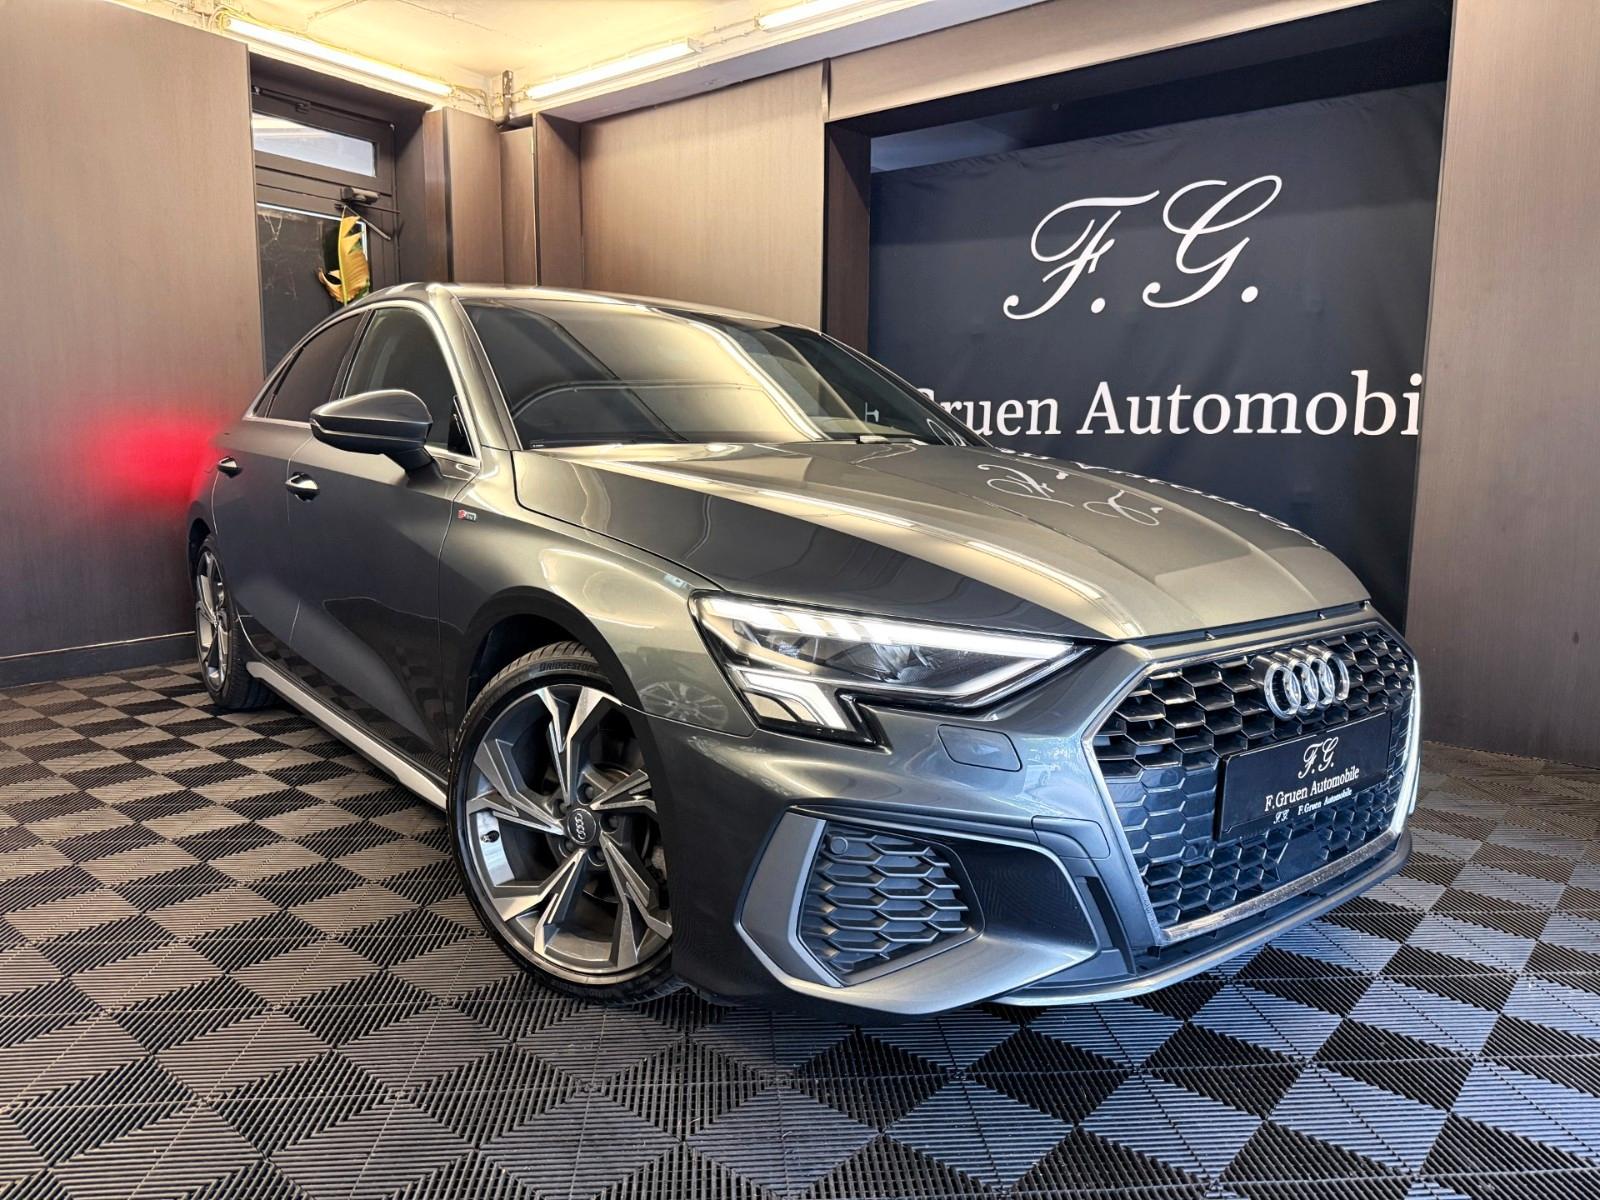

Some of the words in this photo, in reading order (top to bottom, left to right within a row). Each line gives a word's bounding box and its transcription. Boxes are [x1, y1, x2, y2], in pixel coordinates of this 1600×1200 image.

[917, 387, 1062, 436] ruen
[540, 661, 596, 673] BRIDGESTON
[1309, 764, 1360, 797] Automobile
